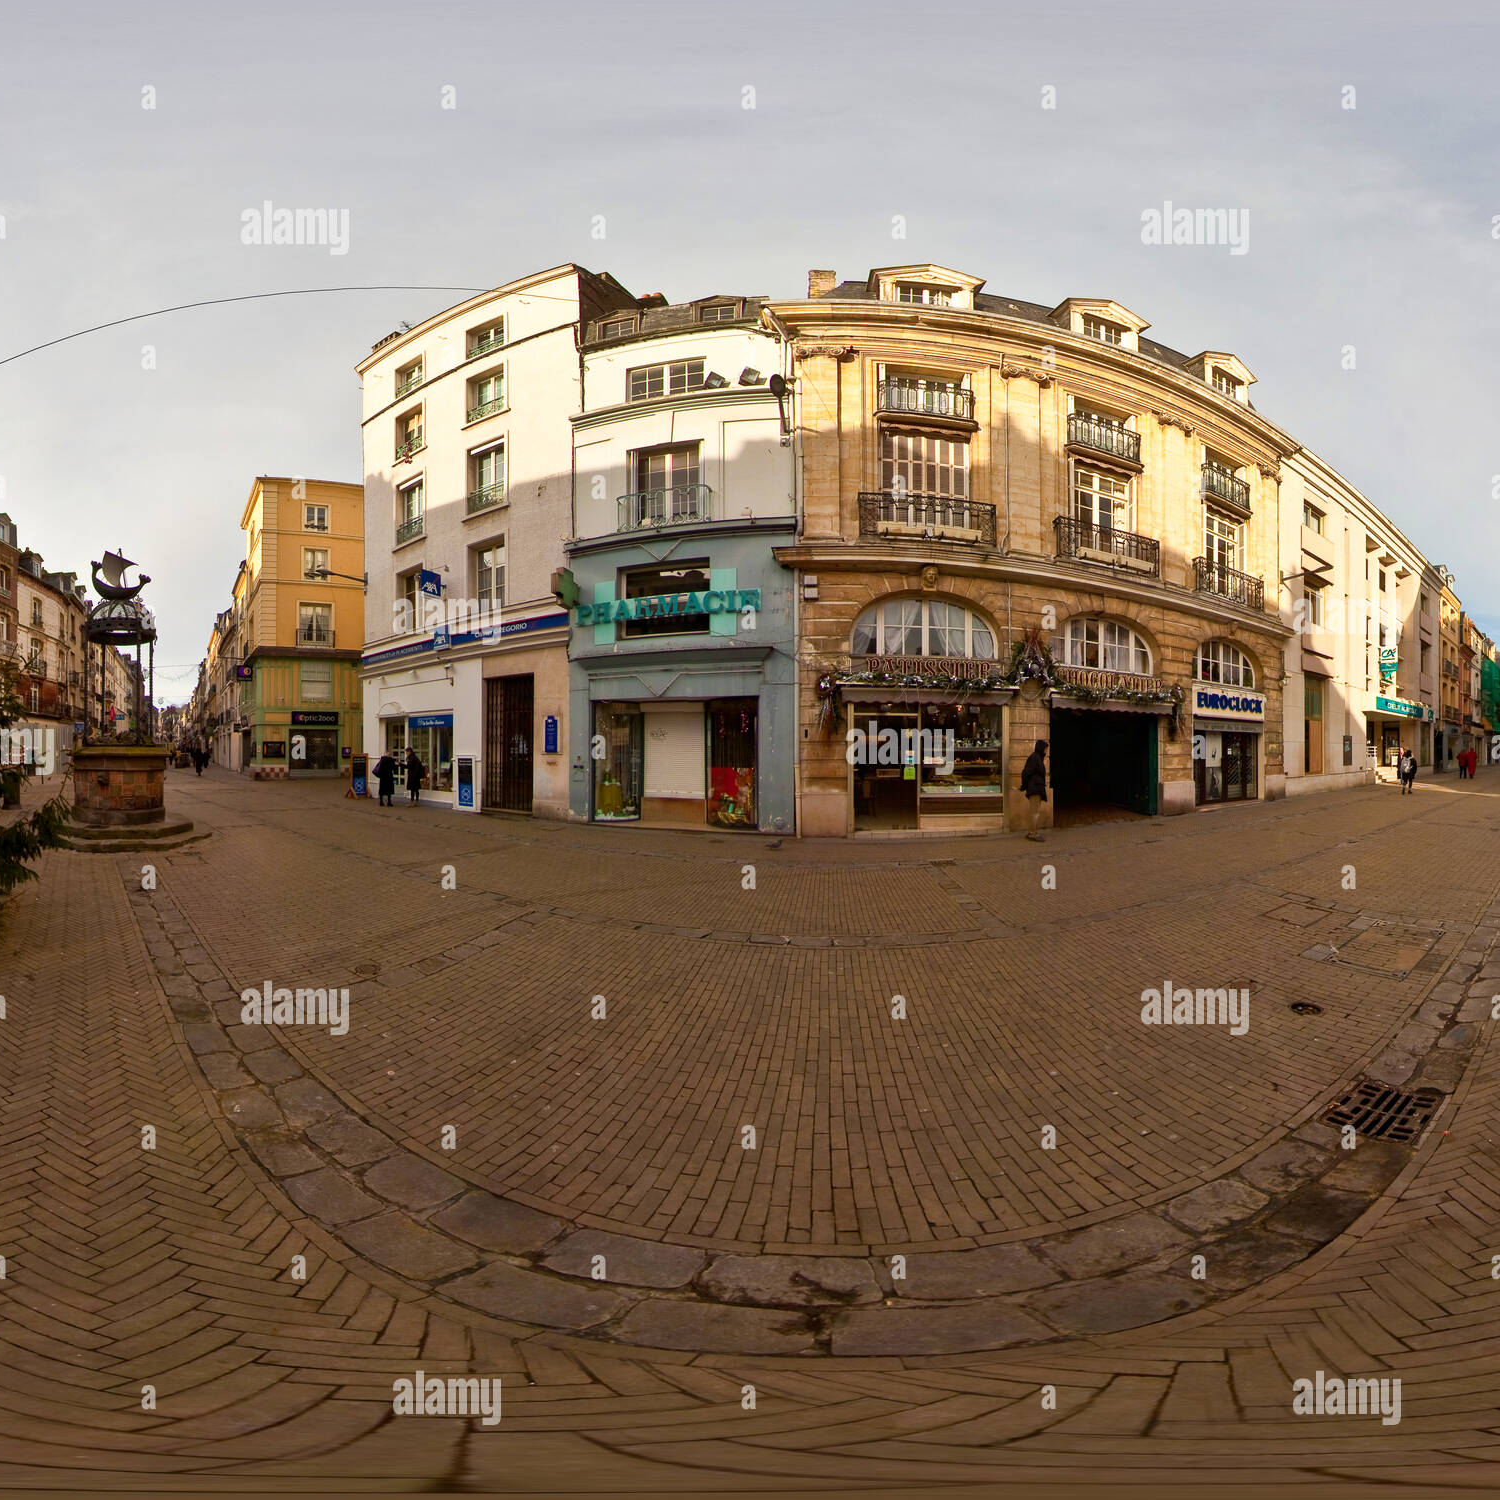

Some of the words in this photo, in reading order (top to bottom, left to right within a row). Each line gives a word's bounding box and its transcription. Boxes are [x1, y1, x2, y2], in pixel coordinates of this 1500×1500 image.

[421, 581, 439, 594] AXA
[575, 589, 760, 626] PHARMACIE
[867, 657, 990, 679] PATISSIER
[1197, 692, 1262, 713] EUROCLOCK
